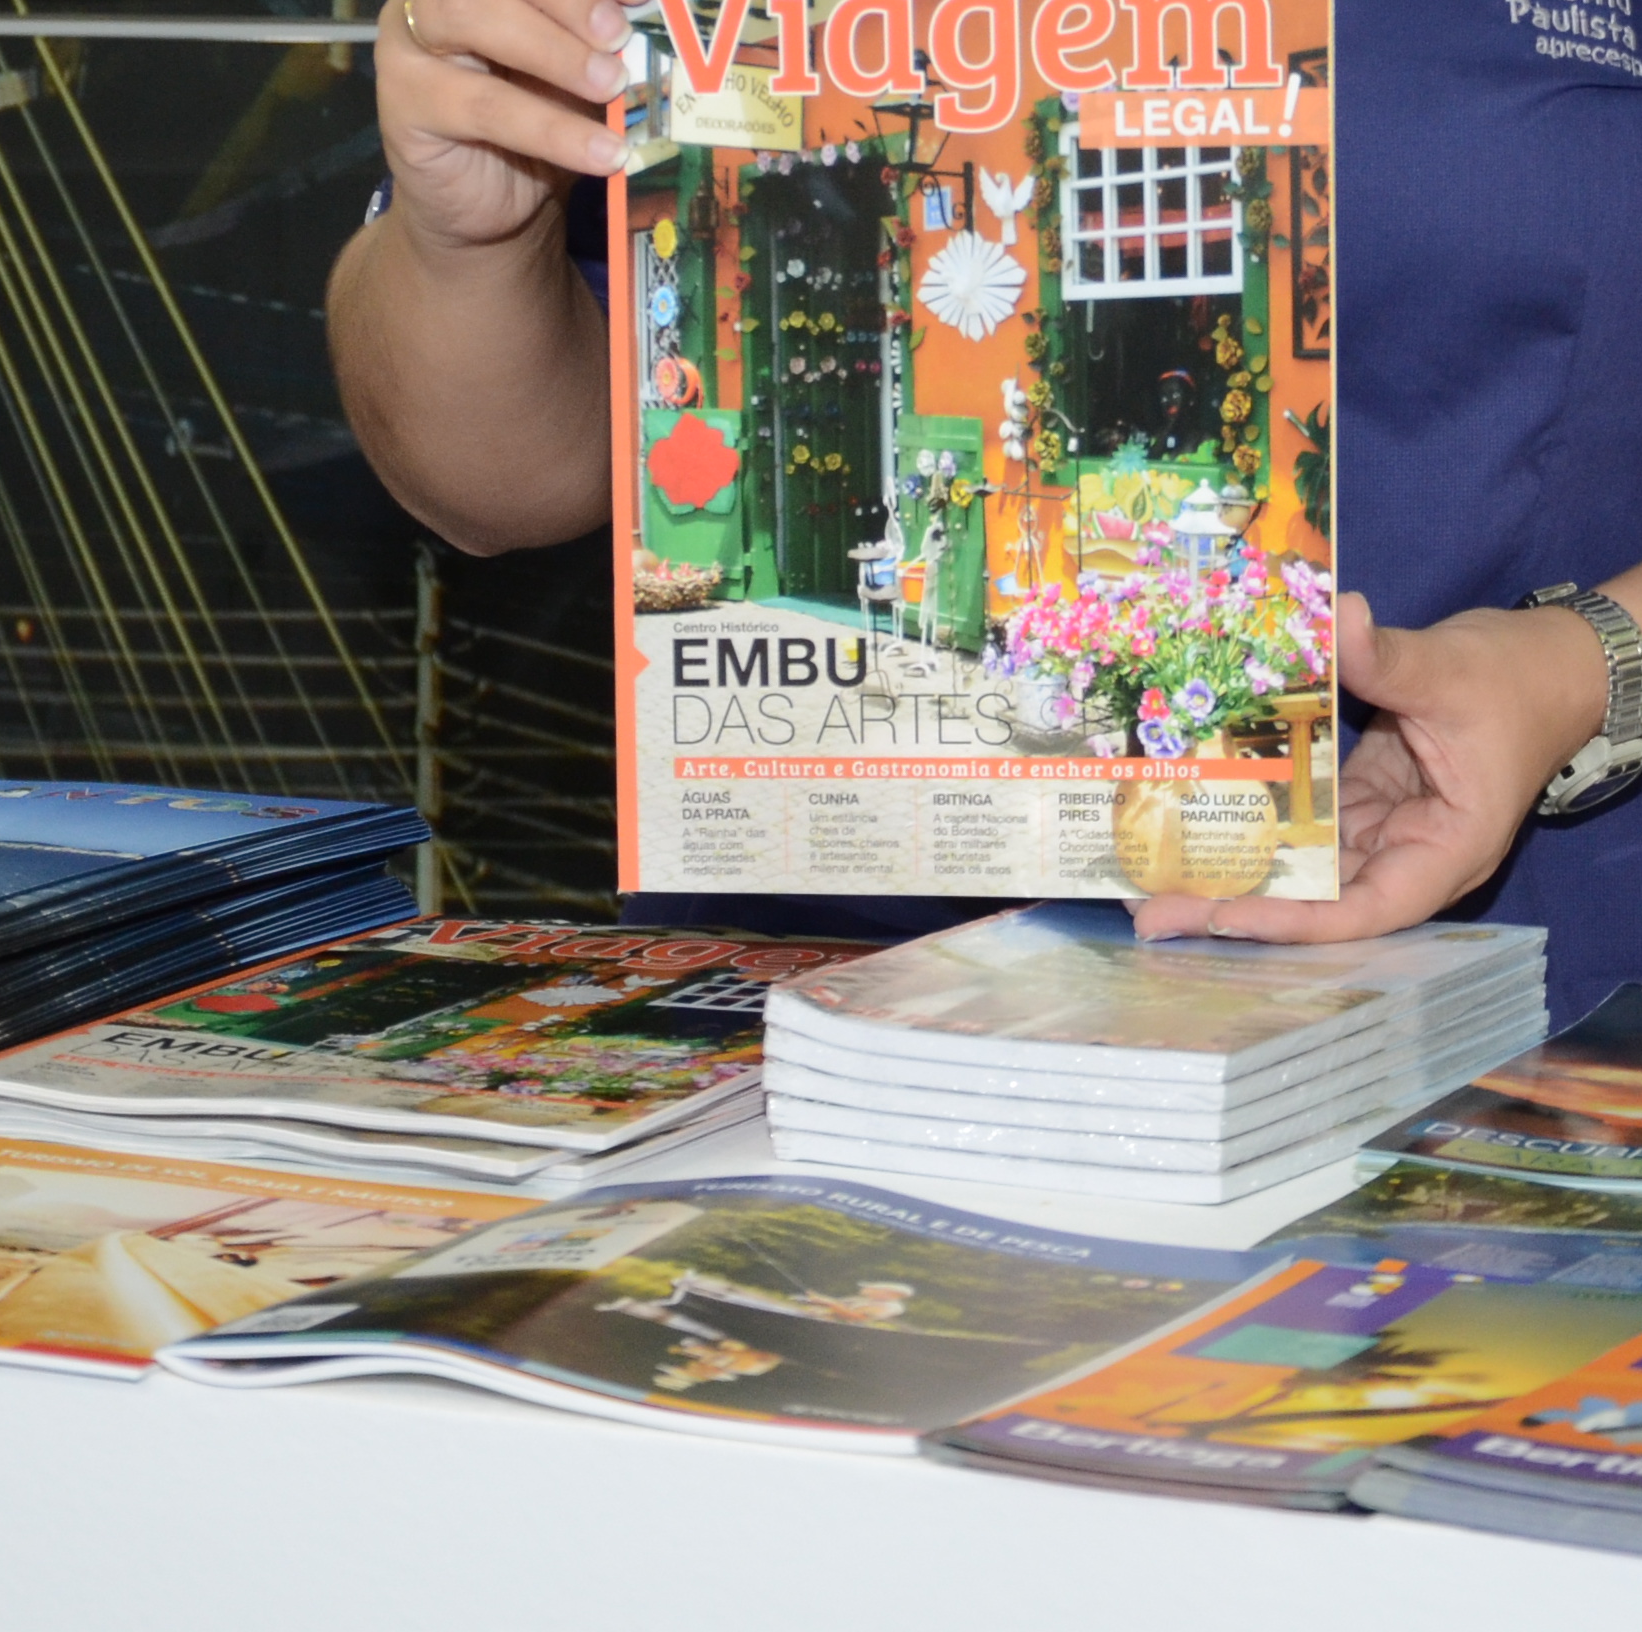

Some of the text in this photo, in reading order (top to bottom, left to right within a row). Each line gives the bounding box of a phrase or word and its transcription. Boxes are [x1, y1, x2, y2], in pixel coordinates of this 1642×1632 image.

[1114, 72, 1302, 138] LEGAL!
[673, 621, 780, 634] Centro Histórico
[672, 637, 868, 688] EMBU
[673, 693, 1013, 746] DAS ARTES
[681, 760, 1201, 779] Arte, Cultura e Gastronomia de encher os olhos
[809, 793, 860, 805] CUNHA
[933, 793, 993, 806] IBITINGA
[1059, 790, 1126, 806] RIBEIRÃO
[1213, 793, 1245, 806] LUIZ
[1249, 794, 1271, 806] DO
[682, 808, 751, 821] DA PRATA
[1059, 810, 1101, 823] PIRES
[1180, 810, 1266, 823] PARAITINGA
[426, 919, 861, 970] Viage
[103, 1031, 297, 1062] EMBU
[827, 1191, 924, 1226] RURAL
[929, 1218, 949, 1231] E
[955, 1224, 996, 1242] DE
[1000, 1235, 1093, 1259] PESCA
